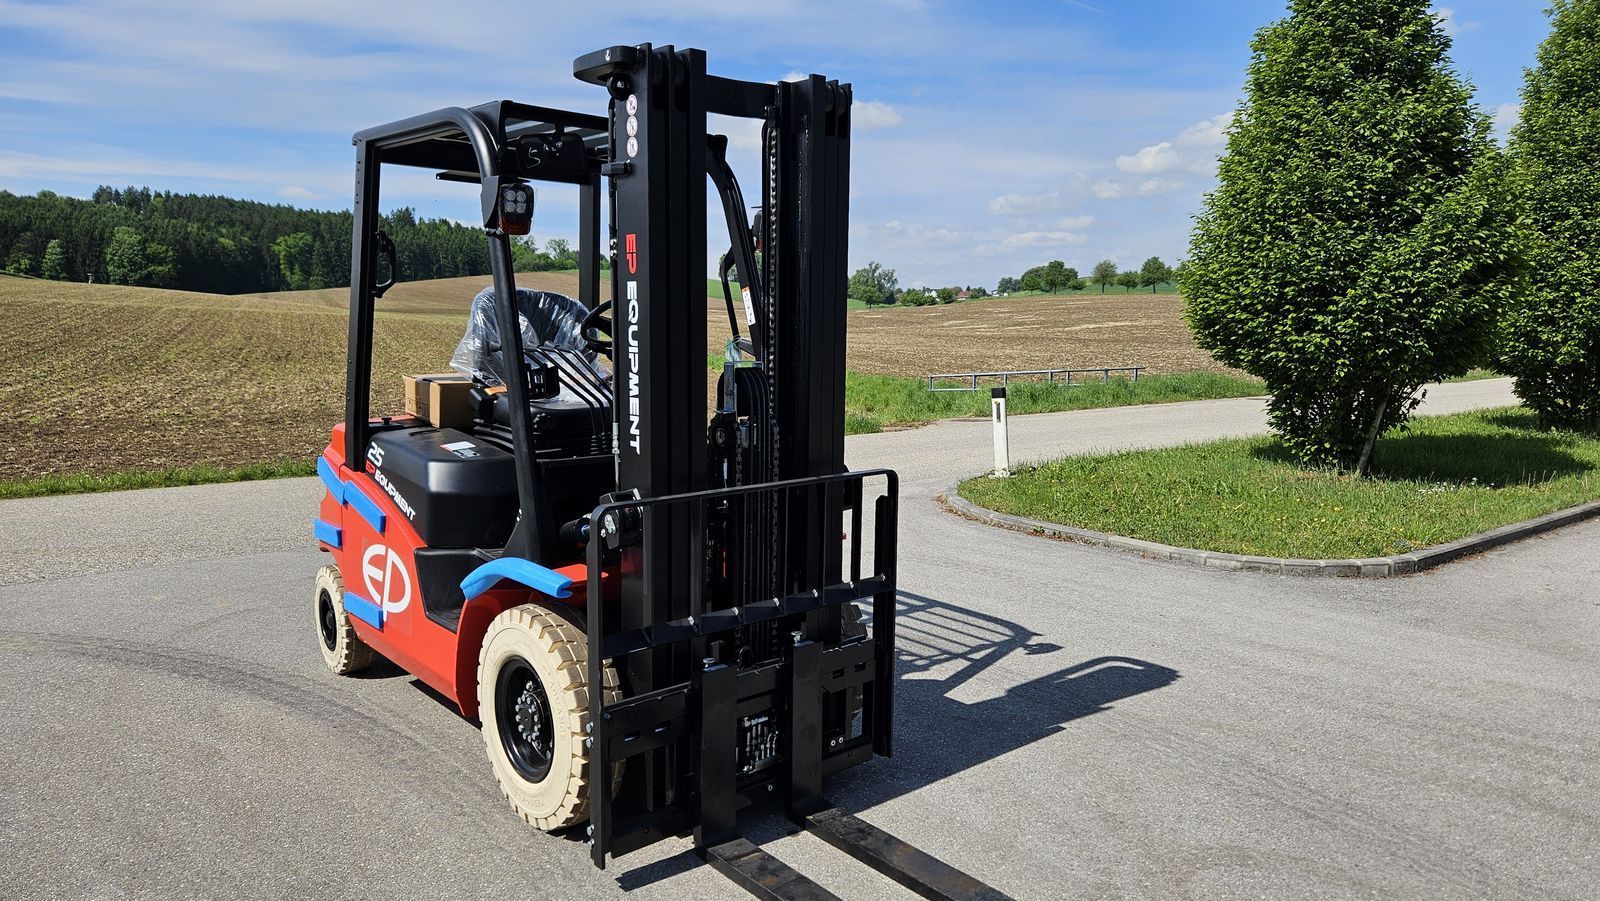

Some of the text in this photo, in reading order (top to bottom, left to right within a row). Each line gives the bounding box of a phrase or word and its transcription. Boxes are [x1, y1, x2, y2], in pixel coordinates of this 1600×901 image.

[626, 233, 641, 455] EP EQUIPMENT
[367, 441, 385, 467] 25
[365, 461, 416, 521] EP EQUIPMENT
